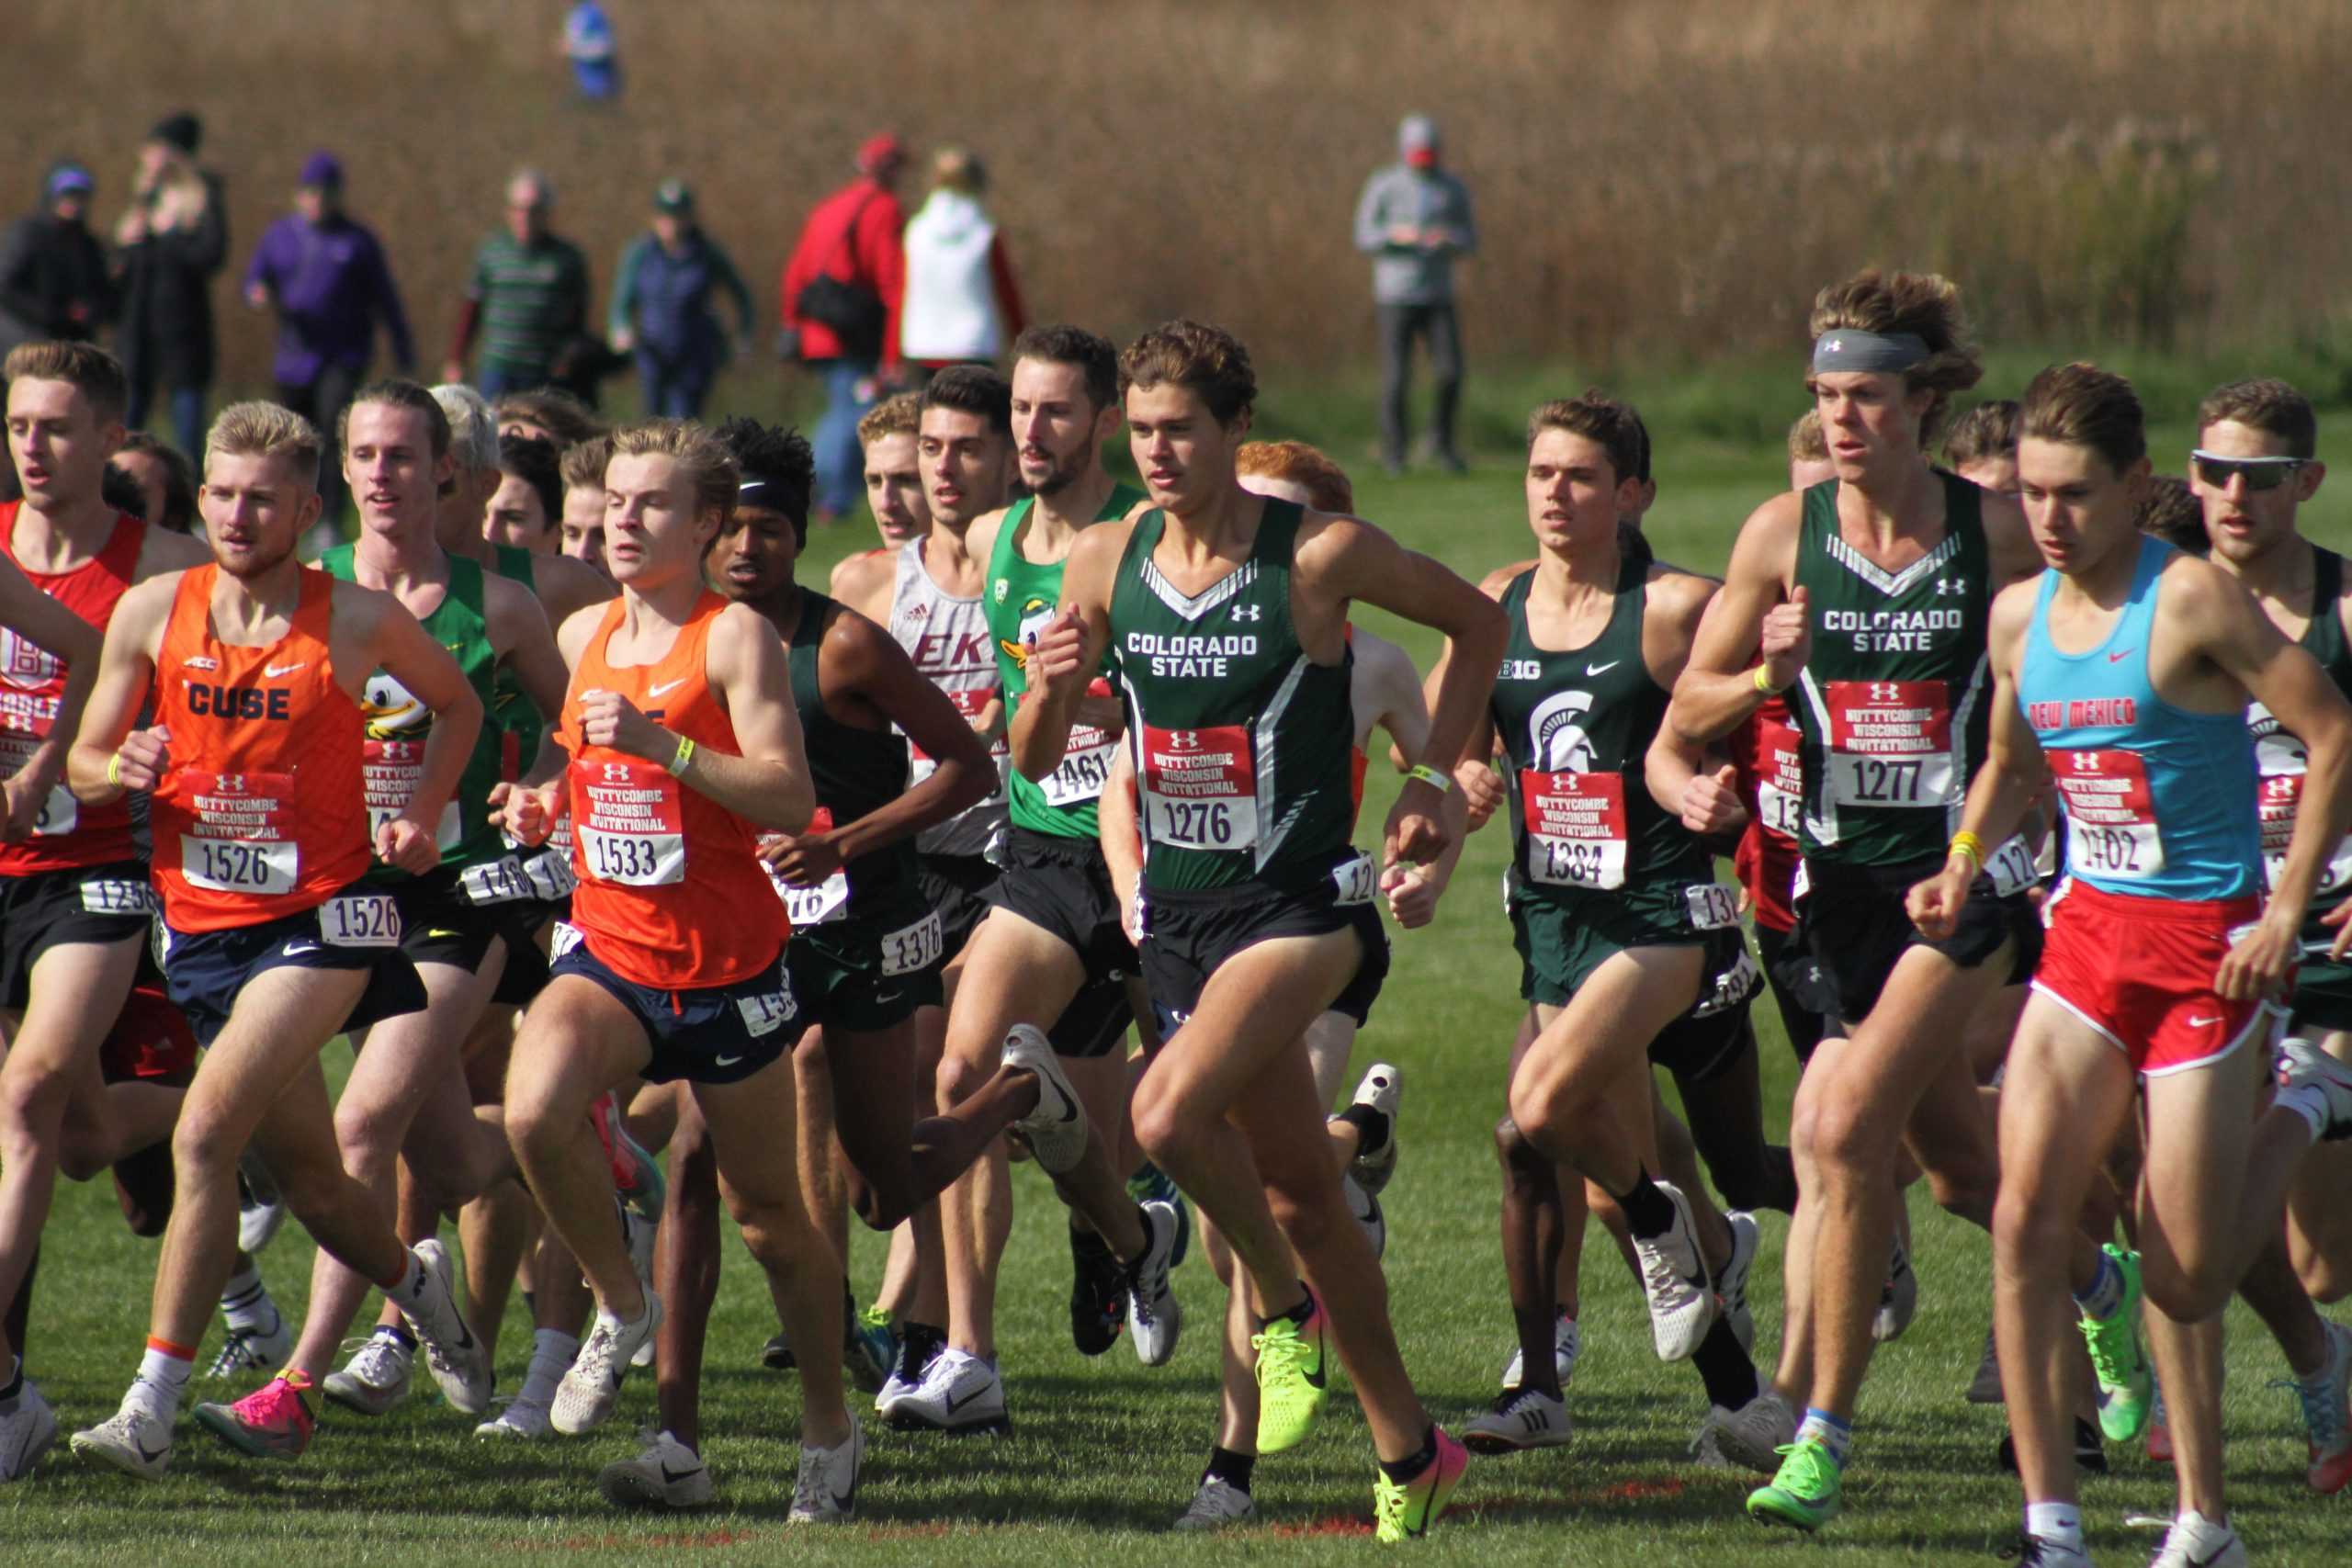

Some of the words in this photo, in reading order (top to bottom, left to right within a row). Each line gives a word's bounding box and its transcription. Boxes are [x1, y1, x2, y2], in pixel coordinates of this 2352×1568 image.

[1824, 610, 1962, 631] COLORADO
[912, 632, 996, 666] EK
[1128, 632, 1257, 656] COLORADO
[1853, 632, 1932, 652] STATE
[1152, 657, 1227, 677] STATE
[188, 682, 291, 720] CUSE
[1845, 708, 1933, 723] NUTTYCOMBE
[2029, 701, 2064, 730] NEW
[2068, 698, 2136, 728] MEXICO
[1852, 723, 1921, 738] WISCONSIN
[1846, 737, 1935, 751] INVITATIONAL
[1153, 752, 1234, 768] NUTTYCOMBE
[1160, 767, 1224, 782] WISCONSIN
[1851, 760, 1922, 801] 1277
[587, 785, 662, 803] NUTTYCOMBE
[1158, 780, 1238, 795] INVITATIONAL
[193, 795, 278, 811] NUTTYCOMBE
[594, 802, 652, 817] WISCONSIN
[1536, 795, 1609, 811] NUTTYCOMBE
[199, 810, 266, 826] WISCONSIN
[590, 817, 666, 831] INVITATIONAL
[1164, 802, 1231, 844] 1276
[1543, 809, 1600, 824] WISCONSIN
[193, 822, 279, 840] INVITATIONAL
[1540, 821, 1612, 838] INVITATIONAL
[203, 844, 268, 885] 1526
[597, 837, 657, 877] 1533
[1544, 840, 1601, 883] 1384
[335, 897, 398, 937] 1526
[896, 919, 939, 970] 1376
